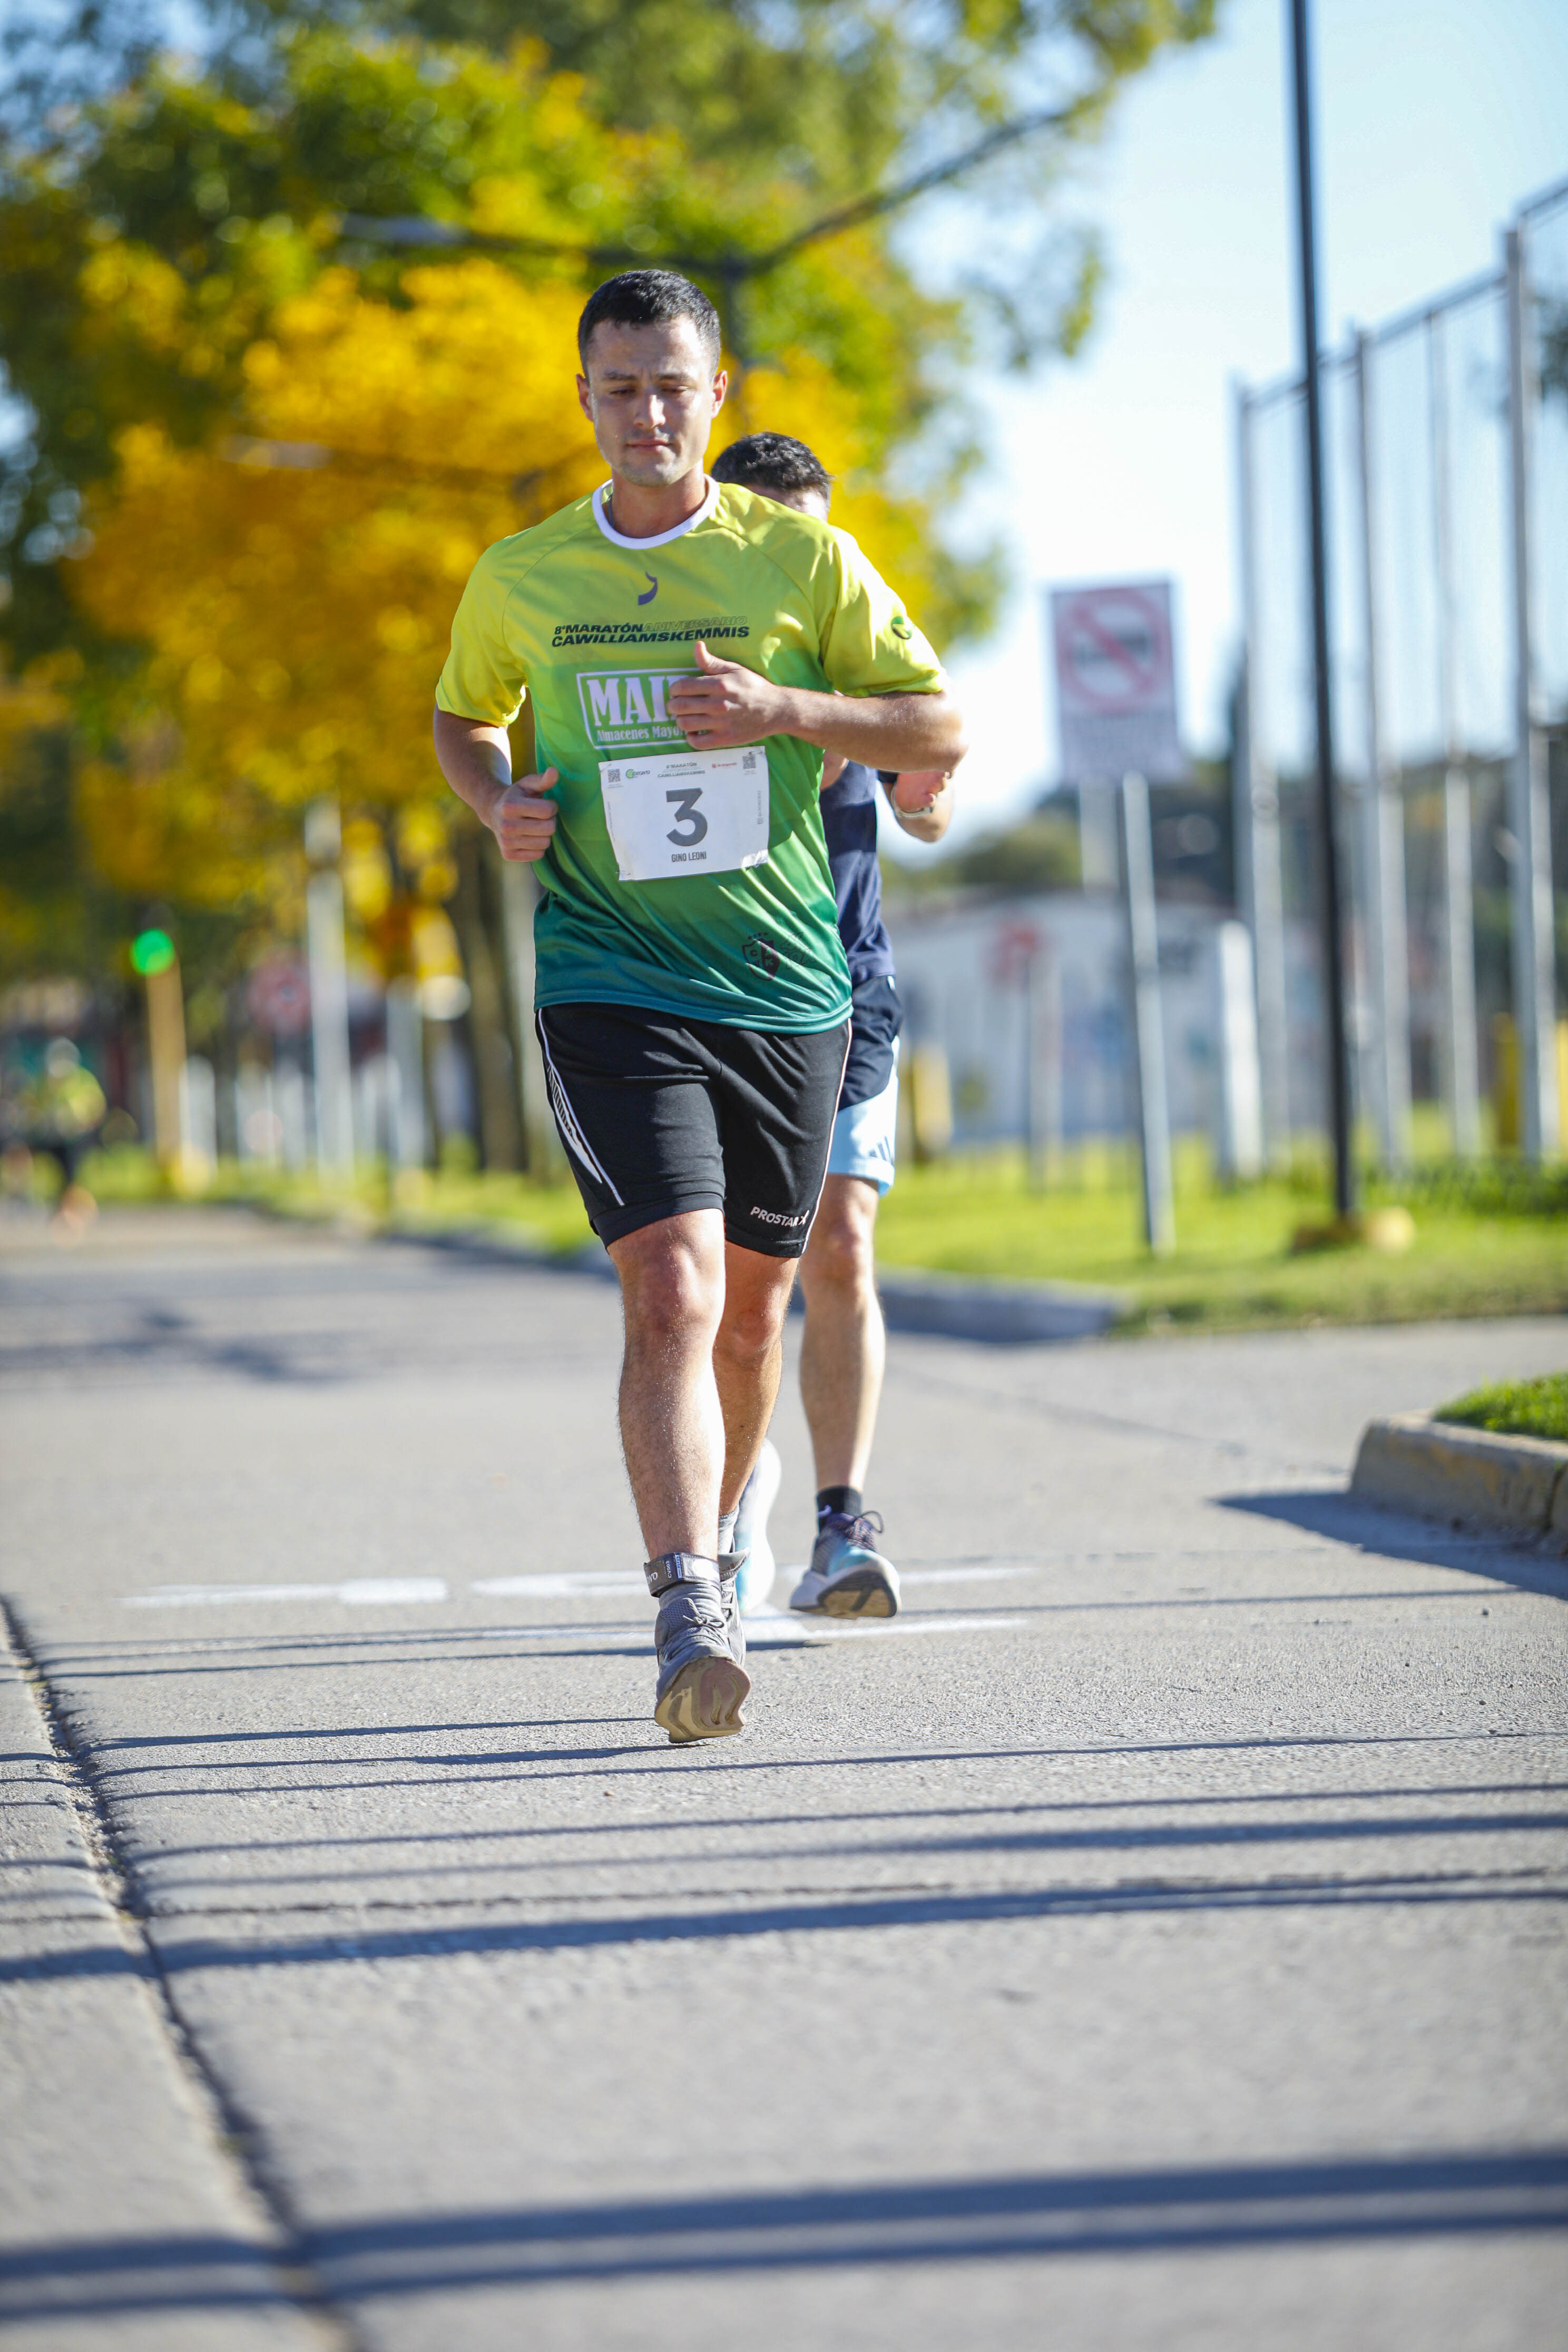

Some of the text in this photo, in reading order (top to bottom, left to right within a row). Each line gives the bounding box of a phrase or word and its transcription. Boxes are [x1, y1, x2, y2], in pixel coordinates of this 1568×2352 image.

[552, 626, 750, 647] CAWILLIAMSKEMMIS
[597, 728, 649, 742] Almacenes
[665, 787, 708, 847] 3
[671, 851, 707, 863] GINO LEONI
